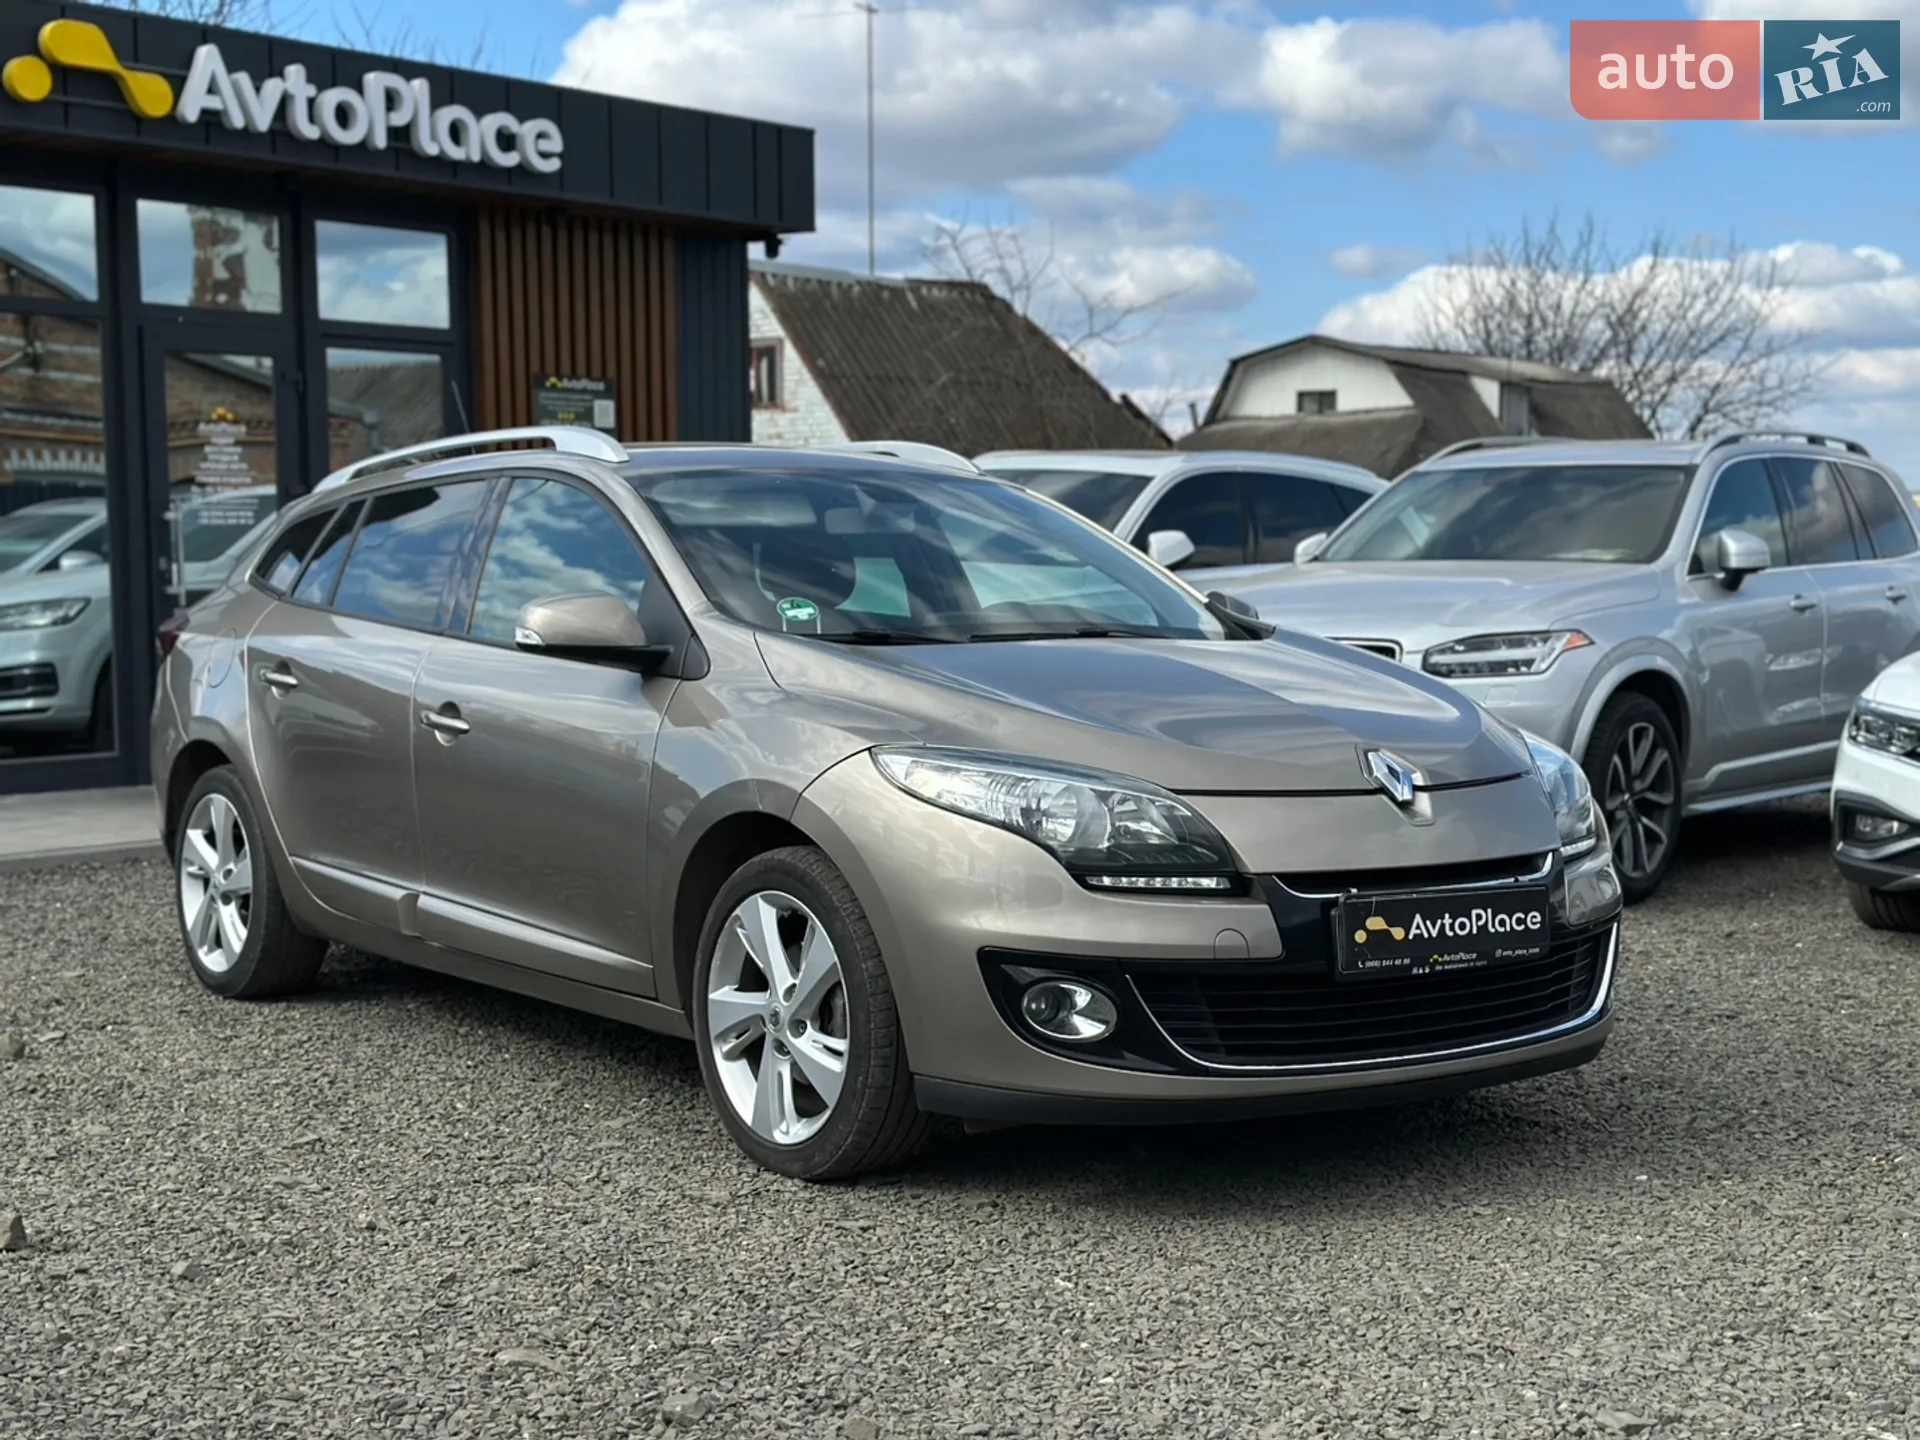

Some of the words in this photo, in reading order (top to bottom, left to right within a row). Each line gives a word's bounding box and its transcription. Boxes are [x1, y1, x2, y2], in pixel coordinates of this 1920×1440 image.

[176, 43, 563, 174] AvtoPlace
[1408, 908, 1542, 940] AvtoPlace
[1443, 951, 1477, 961] AvtoPlace
